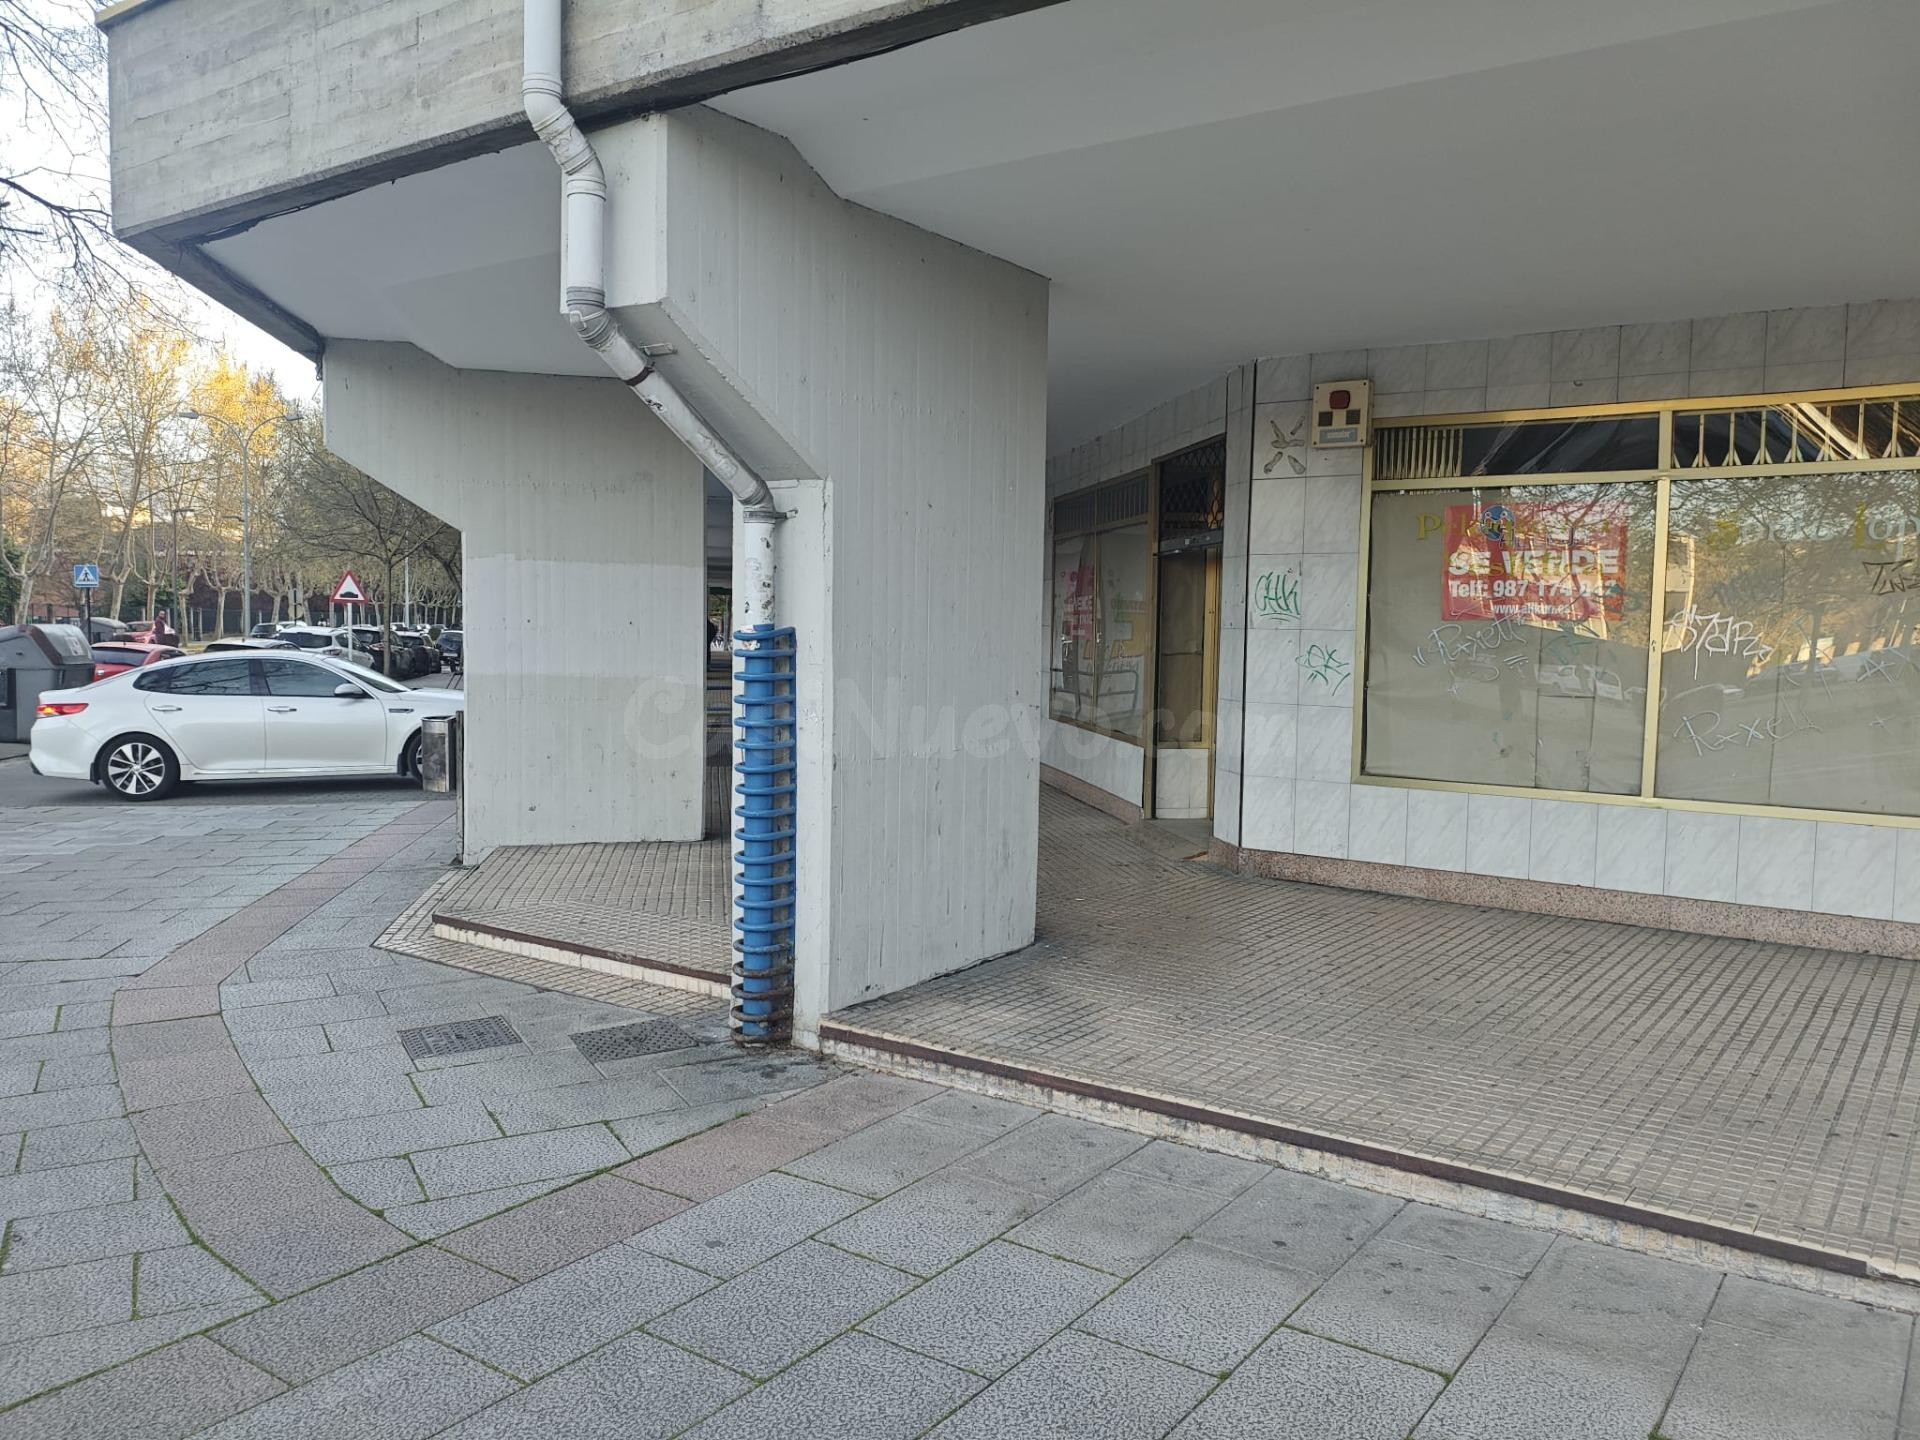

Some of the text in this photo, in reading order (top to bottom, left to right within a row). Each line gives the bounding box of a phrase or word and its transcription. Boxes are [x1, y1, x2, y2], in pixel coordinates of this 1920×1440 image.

[1449, 550, 1619, 575] SE VENDE
[1493, 580, 1529, 597] 987
[1537, 580, 1573, 598] 174
